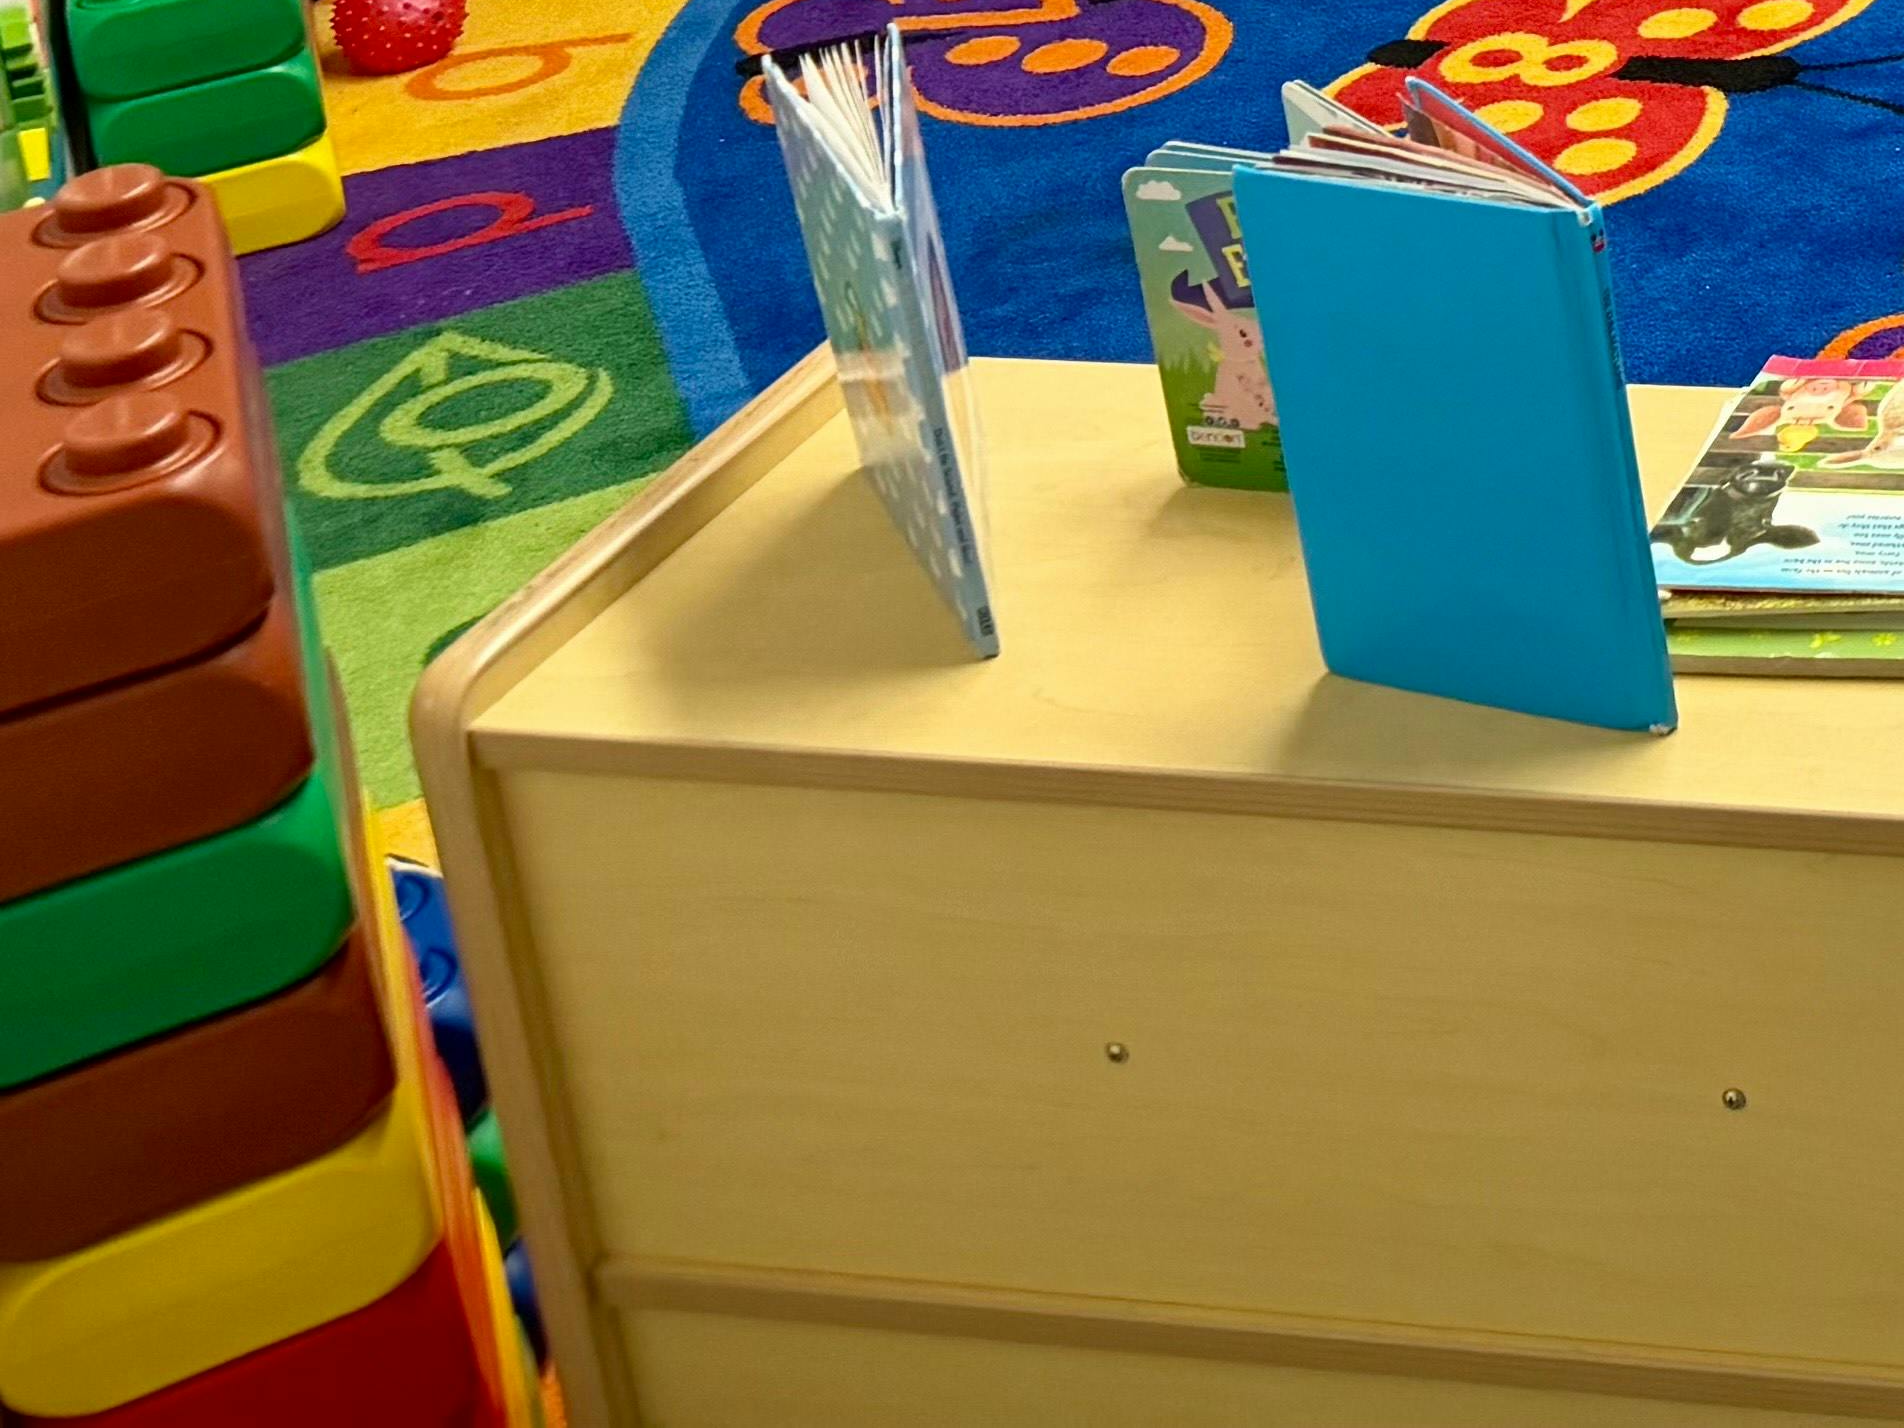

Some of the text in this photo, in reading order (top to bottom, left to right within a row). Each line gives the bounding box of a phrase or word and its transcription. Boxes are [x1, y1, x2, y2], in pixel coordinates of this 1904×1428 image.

[404, 32, 632, 101] q
[1438, 31, 1618, 88] 8
[344, 191, 594, 274] p
